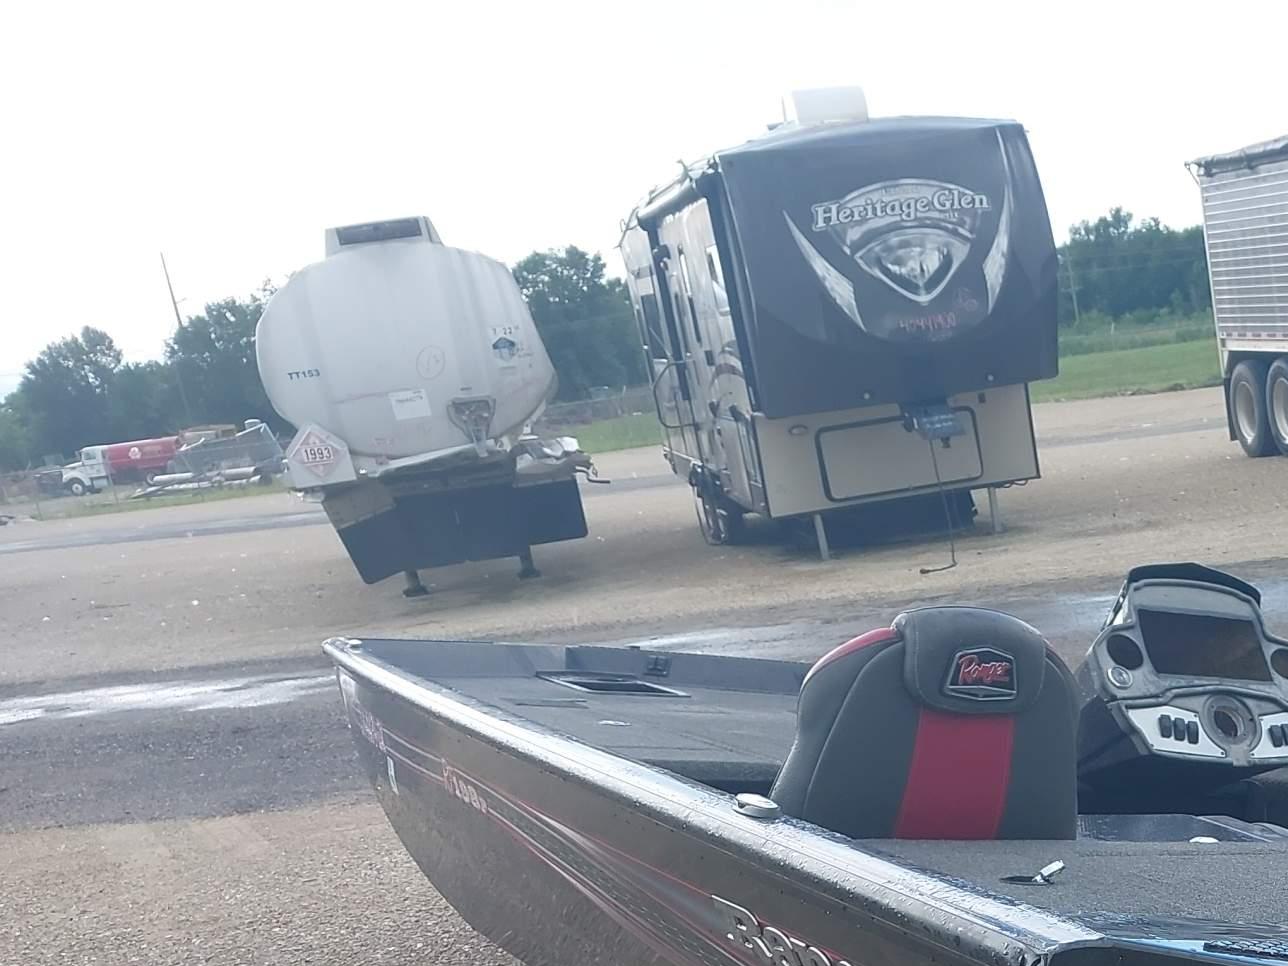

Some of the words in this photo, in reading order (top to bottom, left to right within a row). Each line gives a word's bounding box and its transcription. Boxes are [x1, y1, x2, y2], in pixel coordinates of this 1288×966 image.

[813, 196, 930, 229] Heritage
[933, 189, 990, 210] Glen
[287, 368, 321, 381] TT153
[303, 446, 332, 461] 1993
